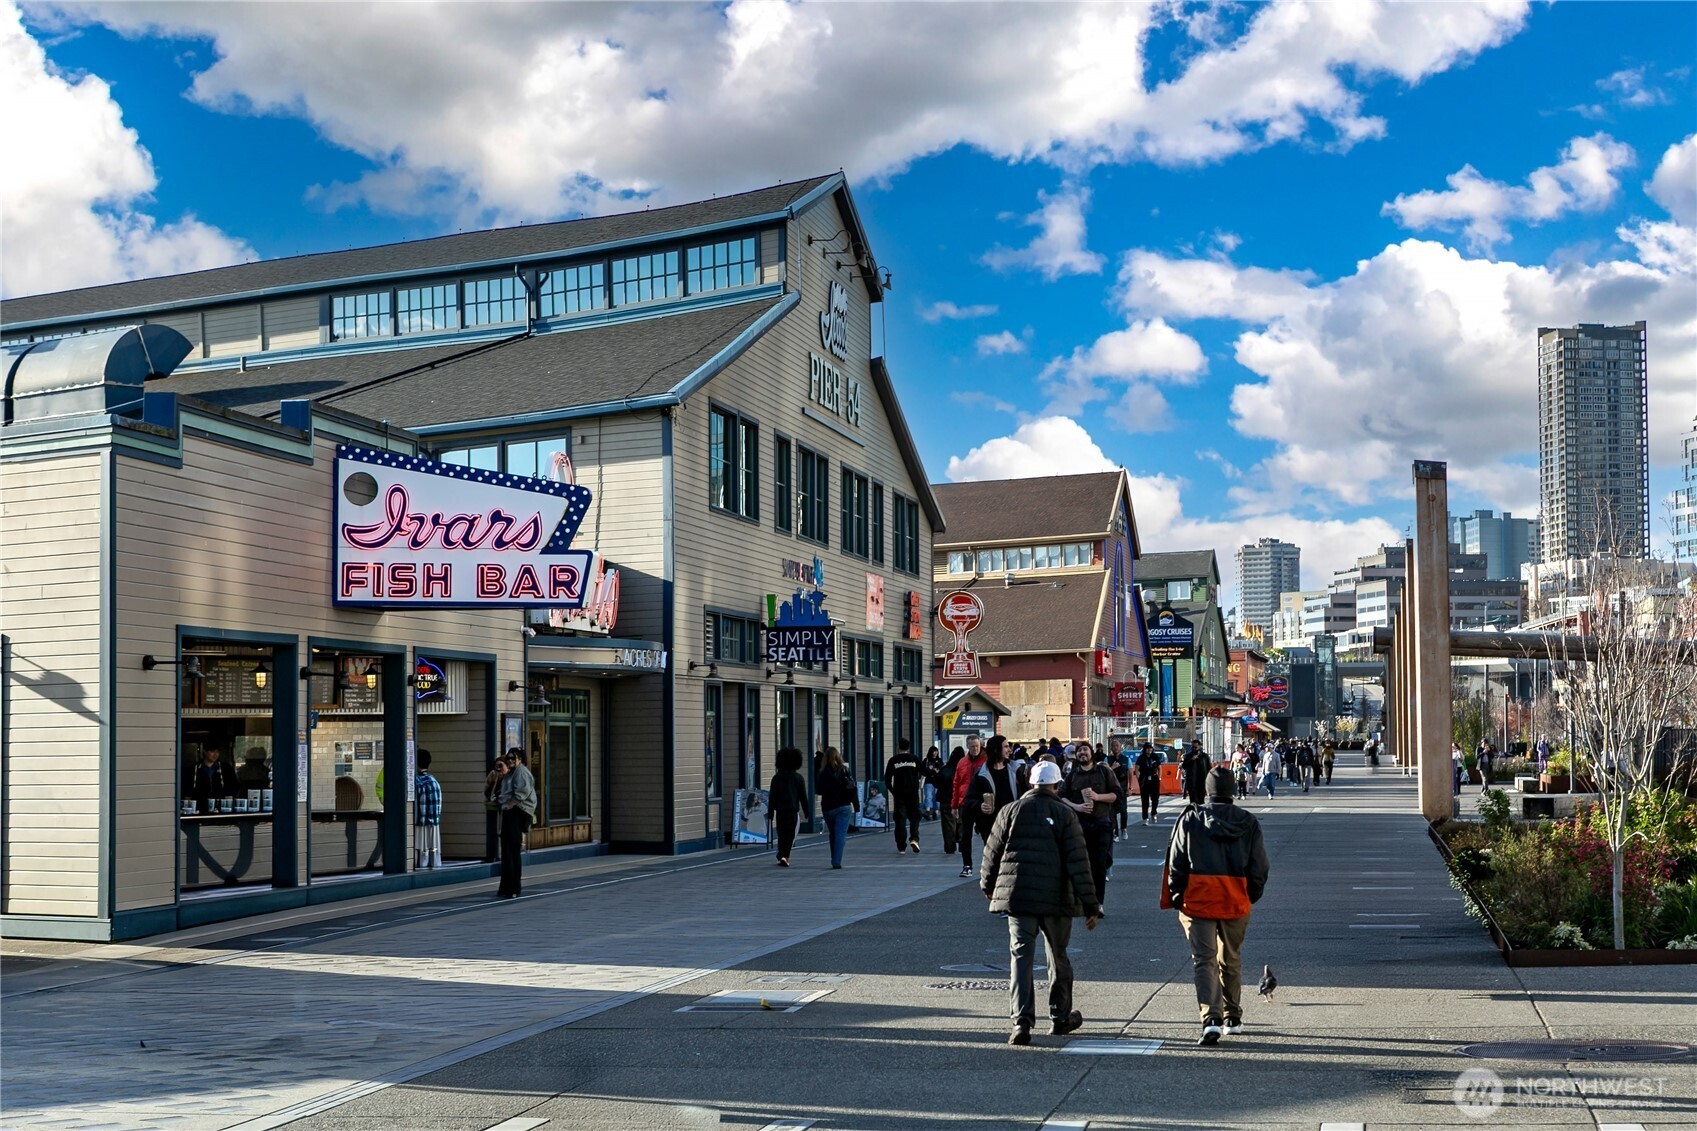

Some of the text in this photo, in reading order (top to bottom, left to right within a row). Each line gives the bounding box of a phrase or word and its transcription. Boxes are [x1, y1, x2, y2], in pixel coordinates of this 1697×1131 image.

[809, 352, 861, 428] PIER 54
[342, 563, 452, 598] FISH
[476, 563, 580, 599] BAR
[769, 631, 832, 646] SIMPLY
[623, 648, 652, 668] ACRES
[769, 647, 833, 661] SEATTLE
